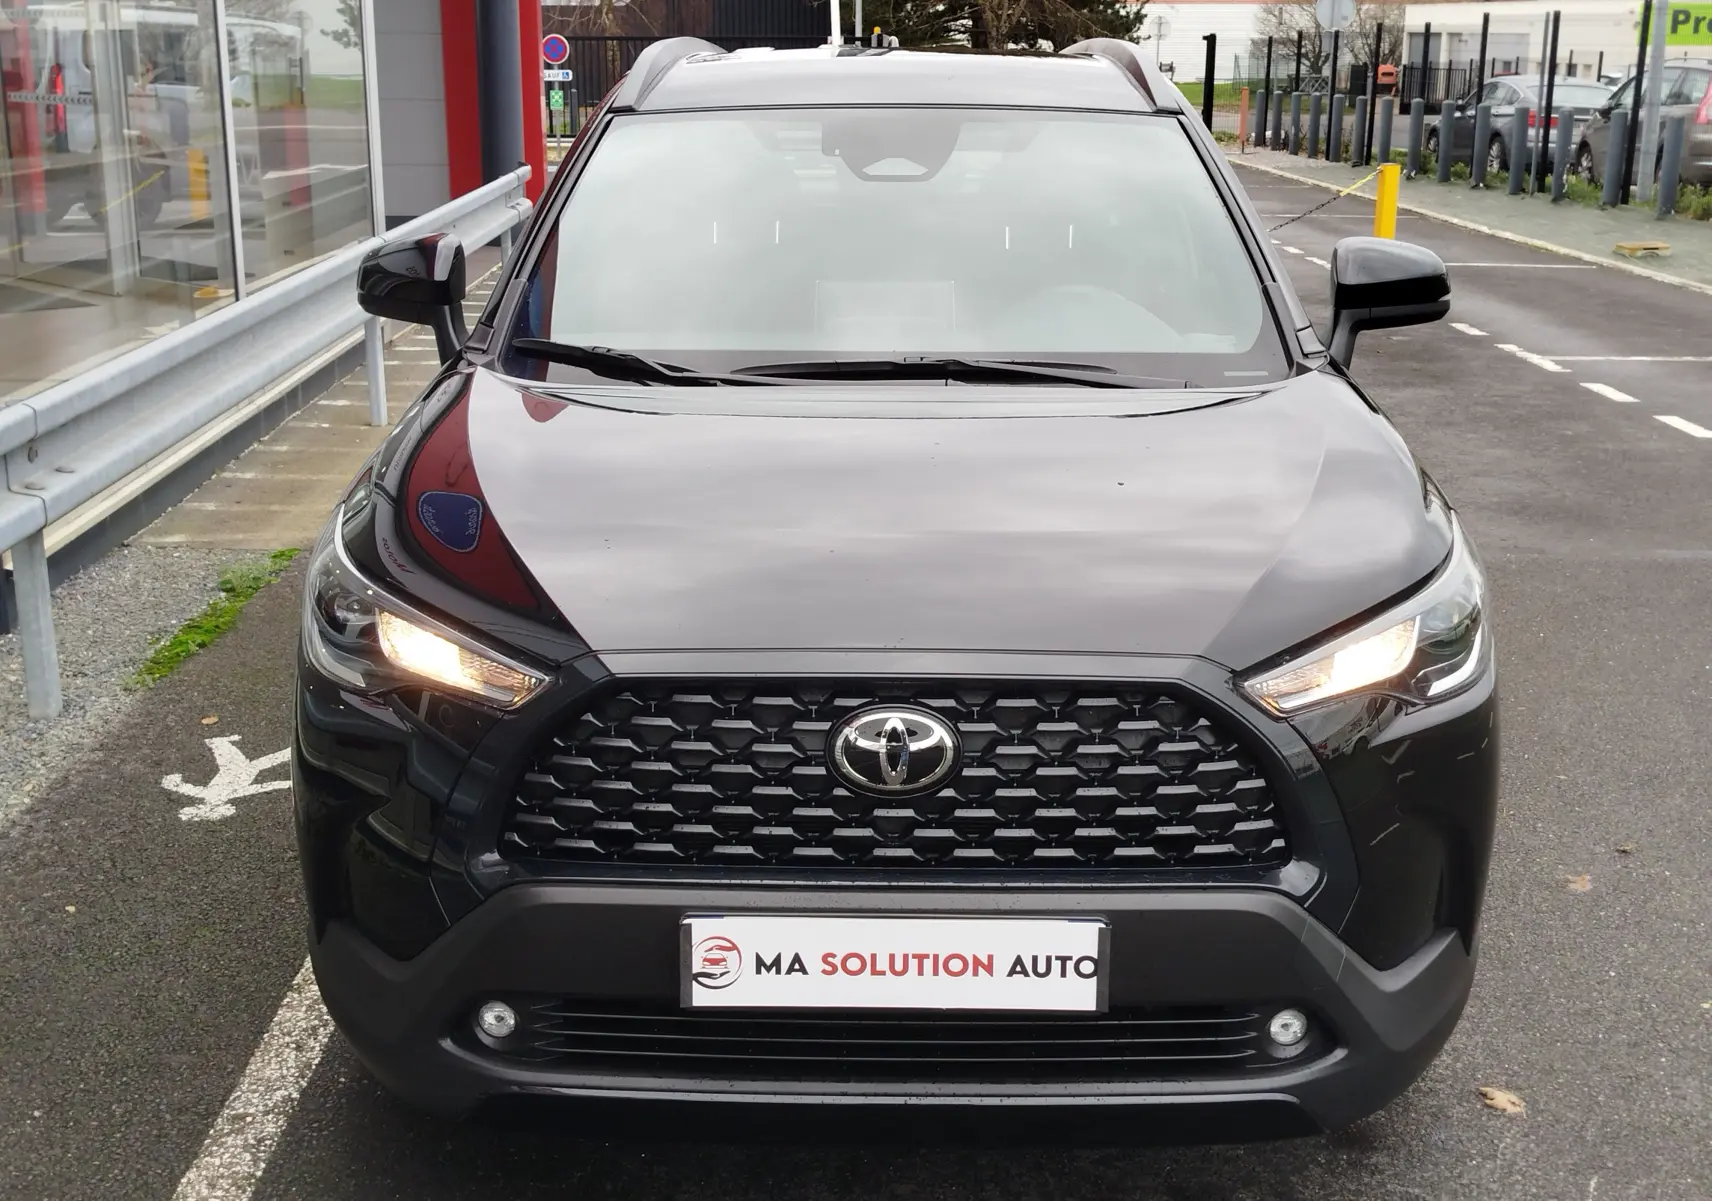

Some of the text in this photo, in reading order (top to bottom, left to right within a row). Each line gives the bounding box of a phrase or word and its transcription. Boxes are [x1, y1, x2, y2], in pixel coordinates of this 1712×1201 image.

[755, 952, 1098, 979] MA SOLUTION AUTO
